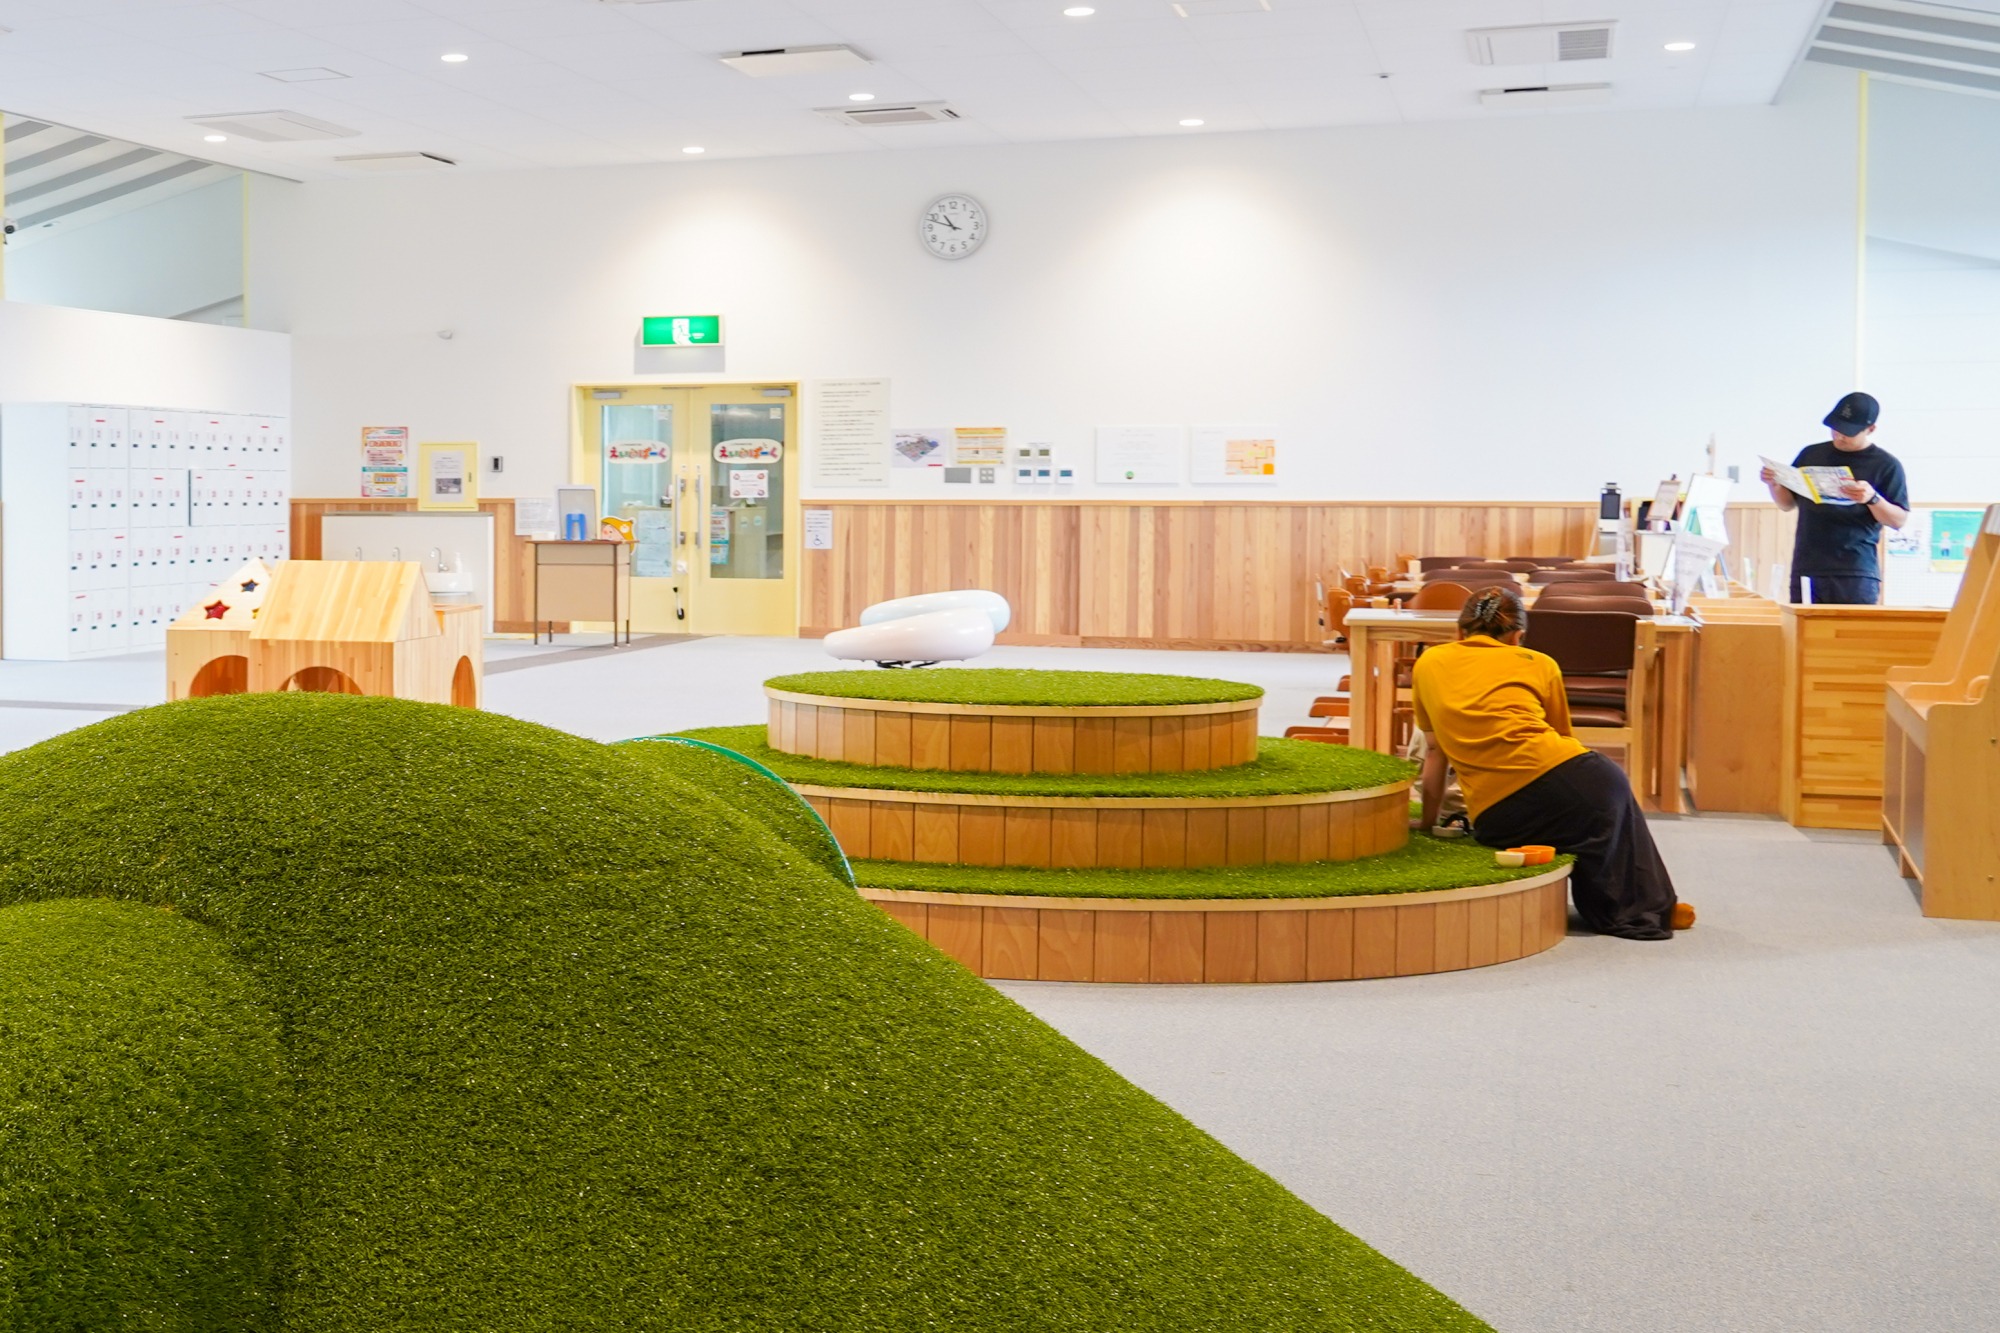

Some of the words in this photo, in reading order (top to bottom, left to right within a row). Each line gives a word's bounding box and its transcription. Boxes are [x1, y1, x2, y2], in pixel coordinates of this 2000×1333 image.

[970, 210, 975, 219] 2
[974, 222, 979, 230] 3
[961, 241, 967, 249] 5
